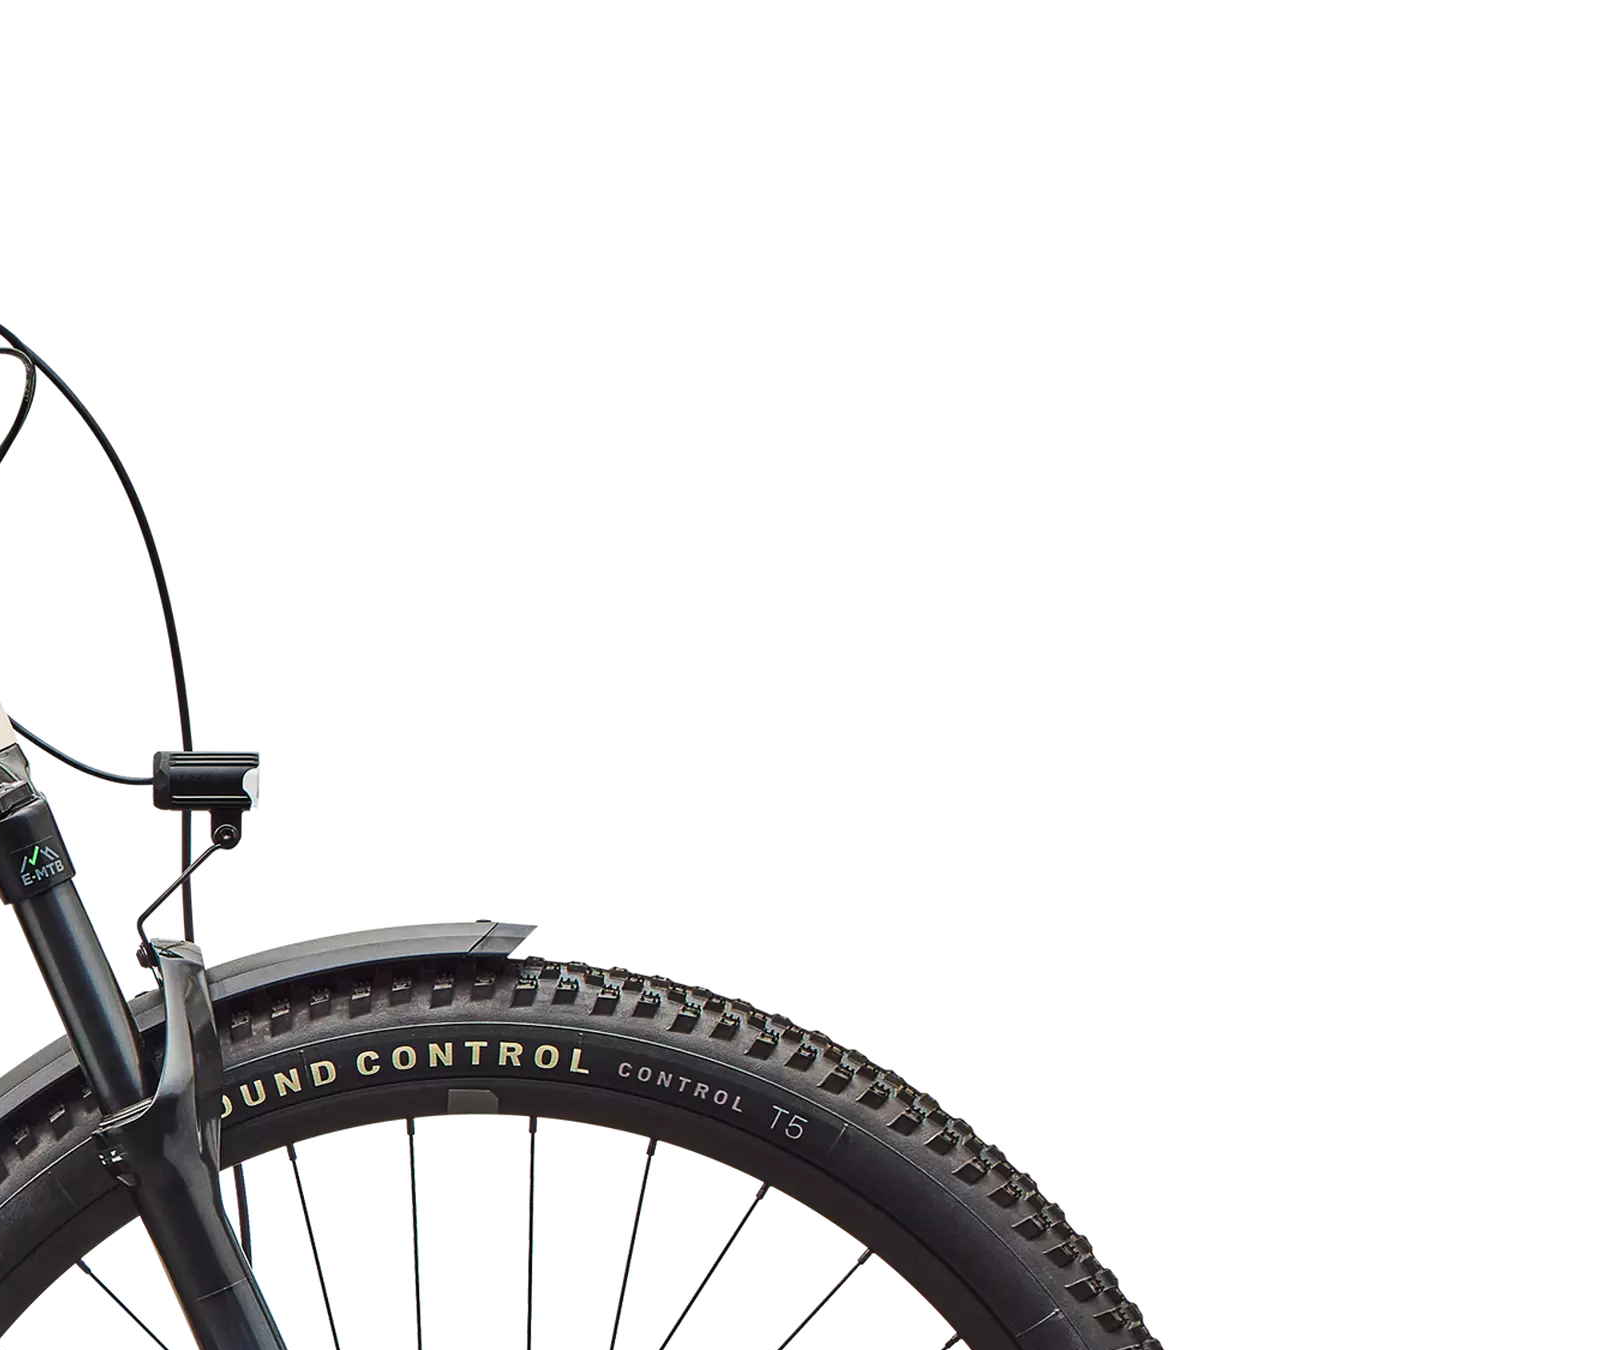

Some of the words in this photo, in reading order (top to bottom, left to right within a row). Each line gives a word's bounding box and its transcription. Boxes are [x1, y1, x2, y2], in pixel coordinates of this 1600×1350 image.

[20, 858, 65, 888] E-MTB
[355, 1040, 591, 1077] CONTROL
[617, 1061, 743, 1114] CONTROL
[770, 1104, 805, 1141] T5
